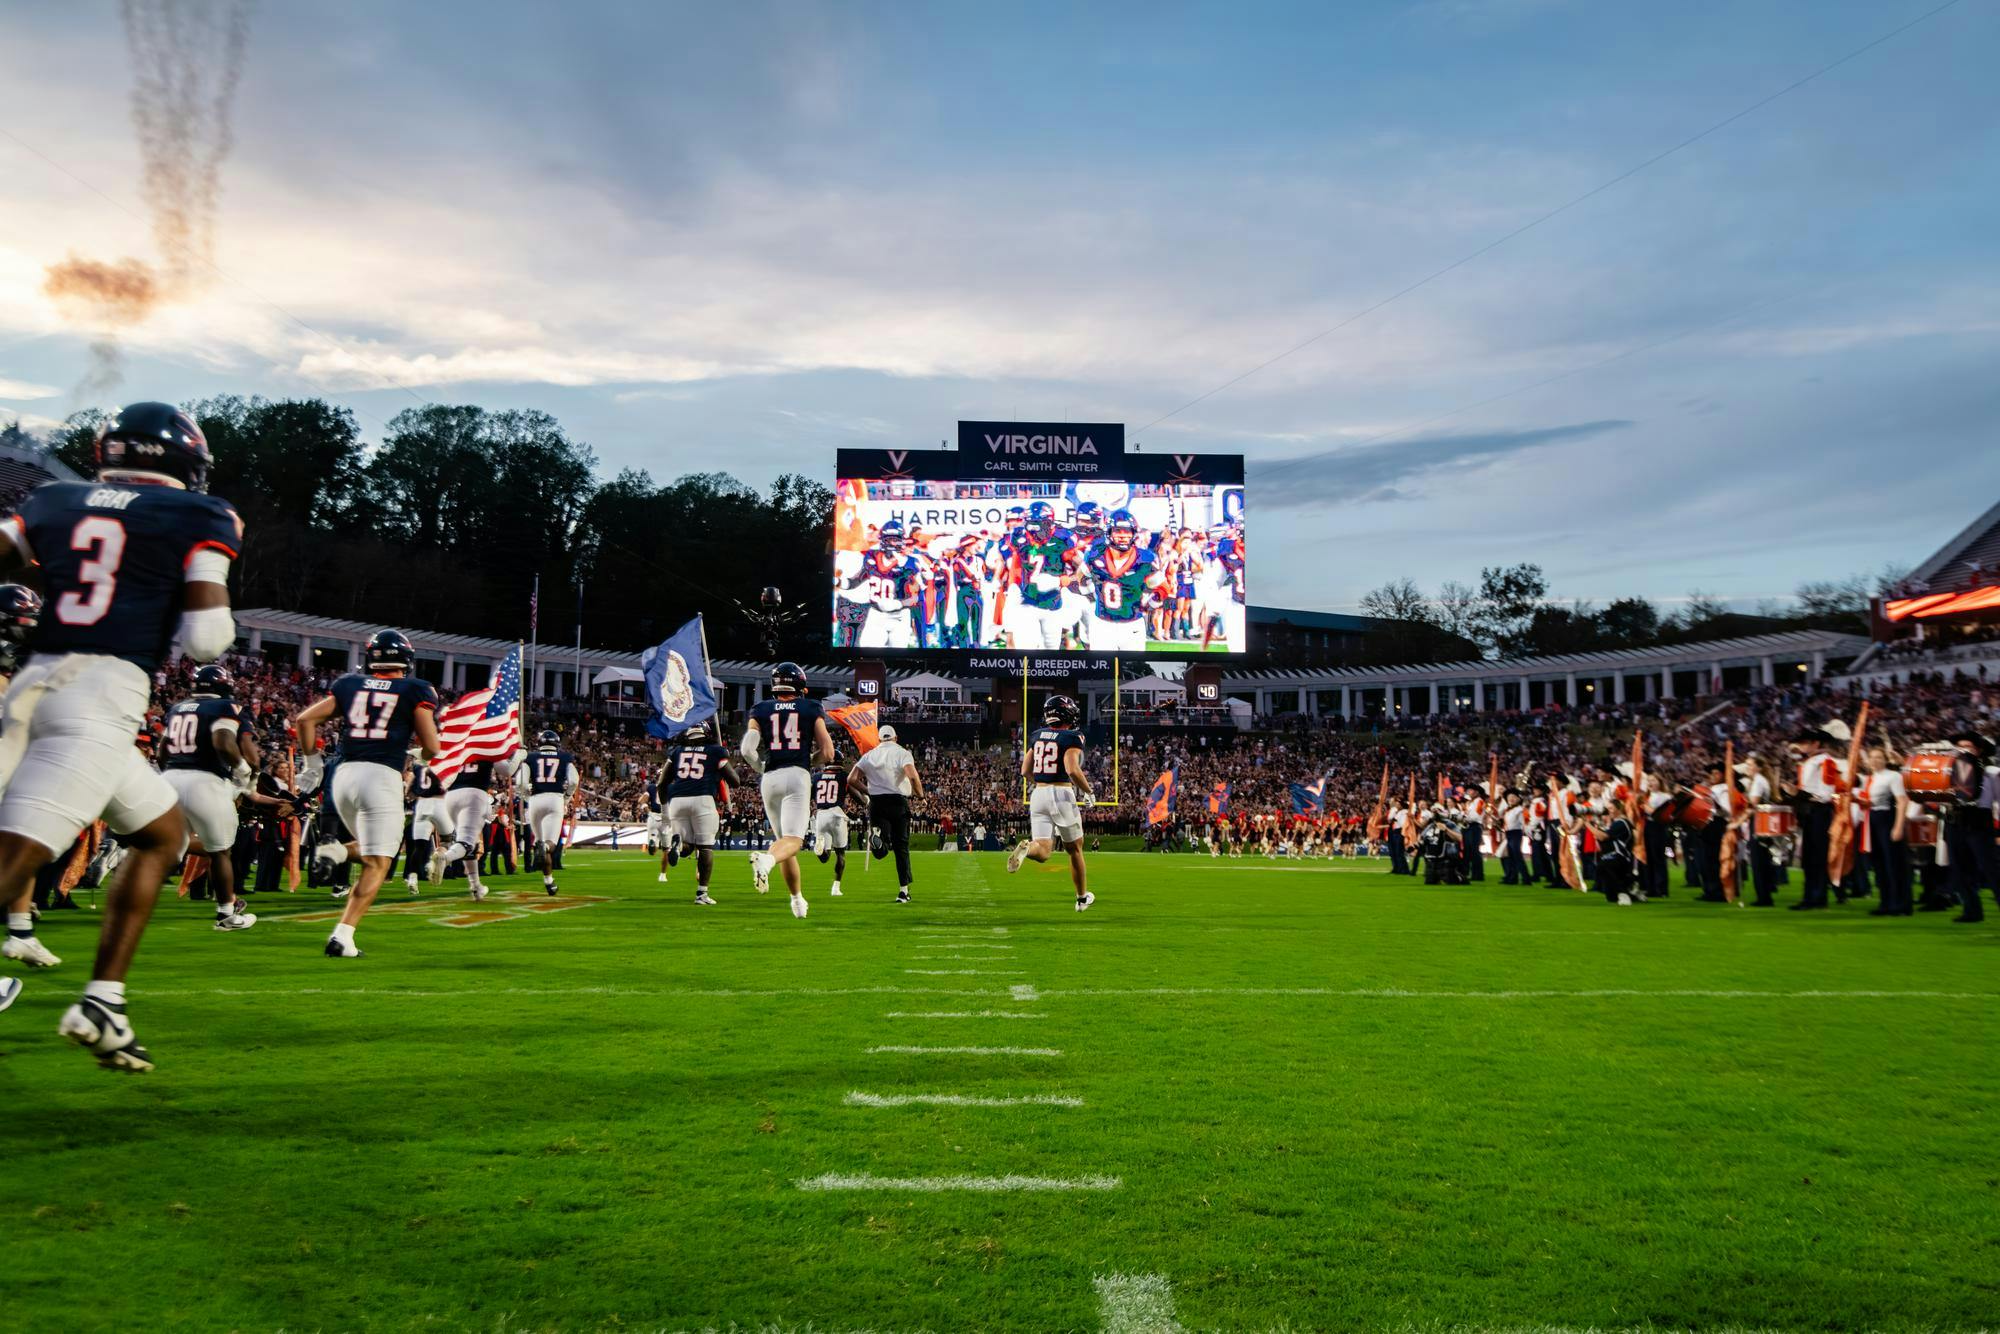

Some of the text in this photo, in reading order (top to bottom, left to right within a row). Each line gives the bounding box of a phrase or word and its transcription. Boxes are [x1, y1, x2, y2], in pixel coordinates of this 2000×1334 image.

[984, 434, 1098, 455] VIRGINIA
[984, 461, 1098, 472] CARL SMITH CENTER
[891, 508, 1009, 526] HARRISO
[56, 515, 127, 626] 3
[1103, 580, 1122, 610] 0
[970, 658, 1015, 668] RAMON
[1091, 660, 1110, 670] JR.
[1009, 668, 1070, 677] VIDEOBOARD
[363, 679, 392, 690] SNEED
[861, 682, 876, 693] 40
[1200, 686, 1215, 698] 40
[348, 690, 399, 739] 47
[843, 711, 876, 730] UVA
[167, 713, 199, 754] 90
[770, 712, 801, 750] 14
[677, 752, 708, 780] 55
[1033, 741, 1058, 774] 82
[536, 758, 560, 783] 17
[816, 780, 839, 804] 20
